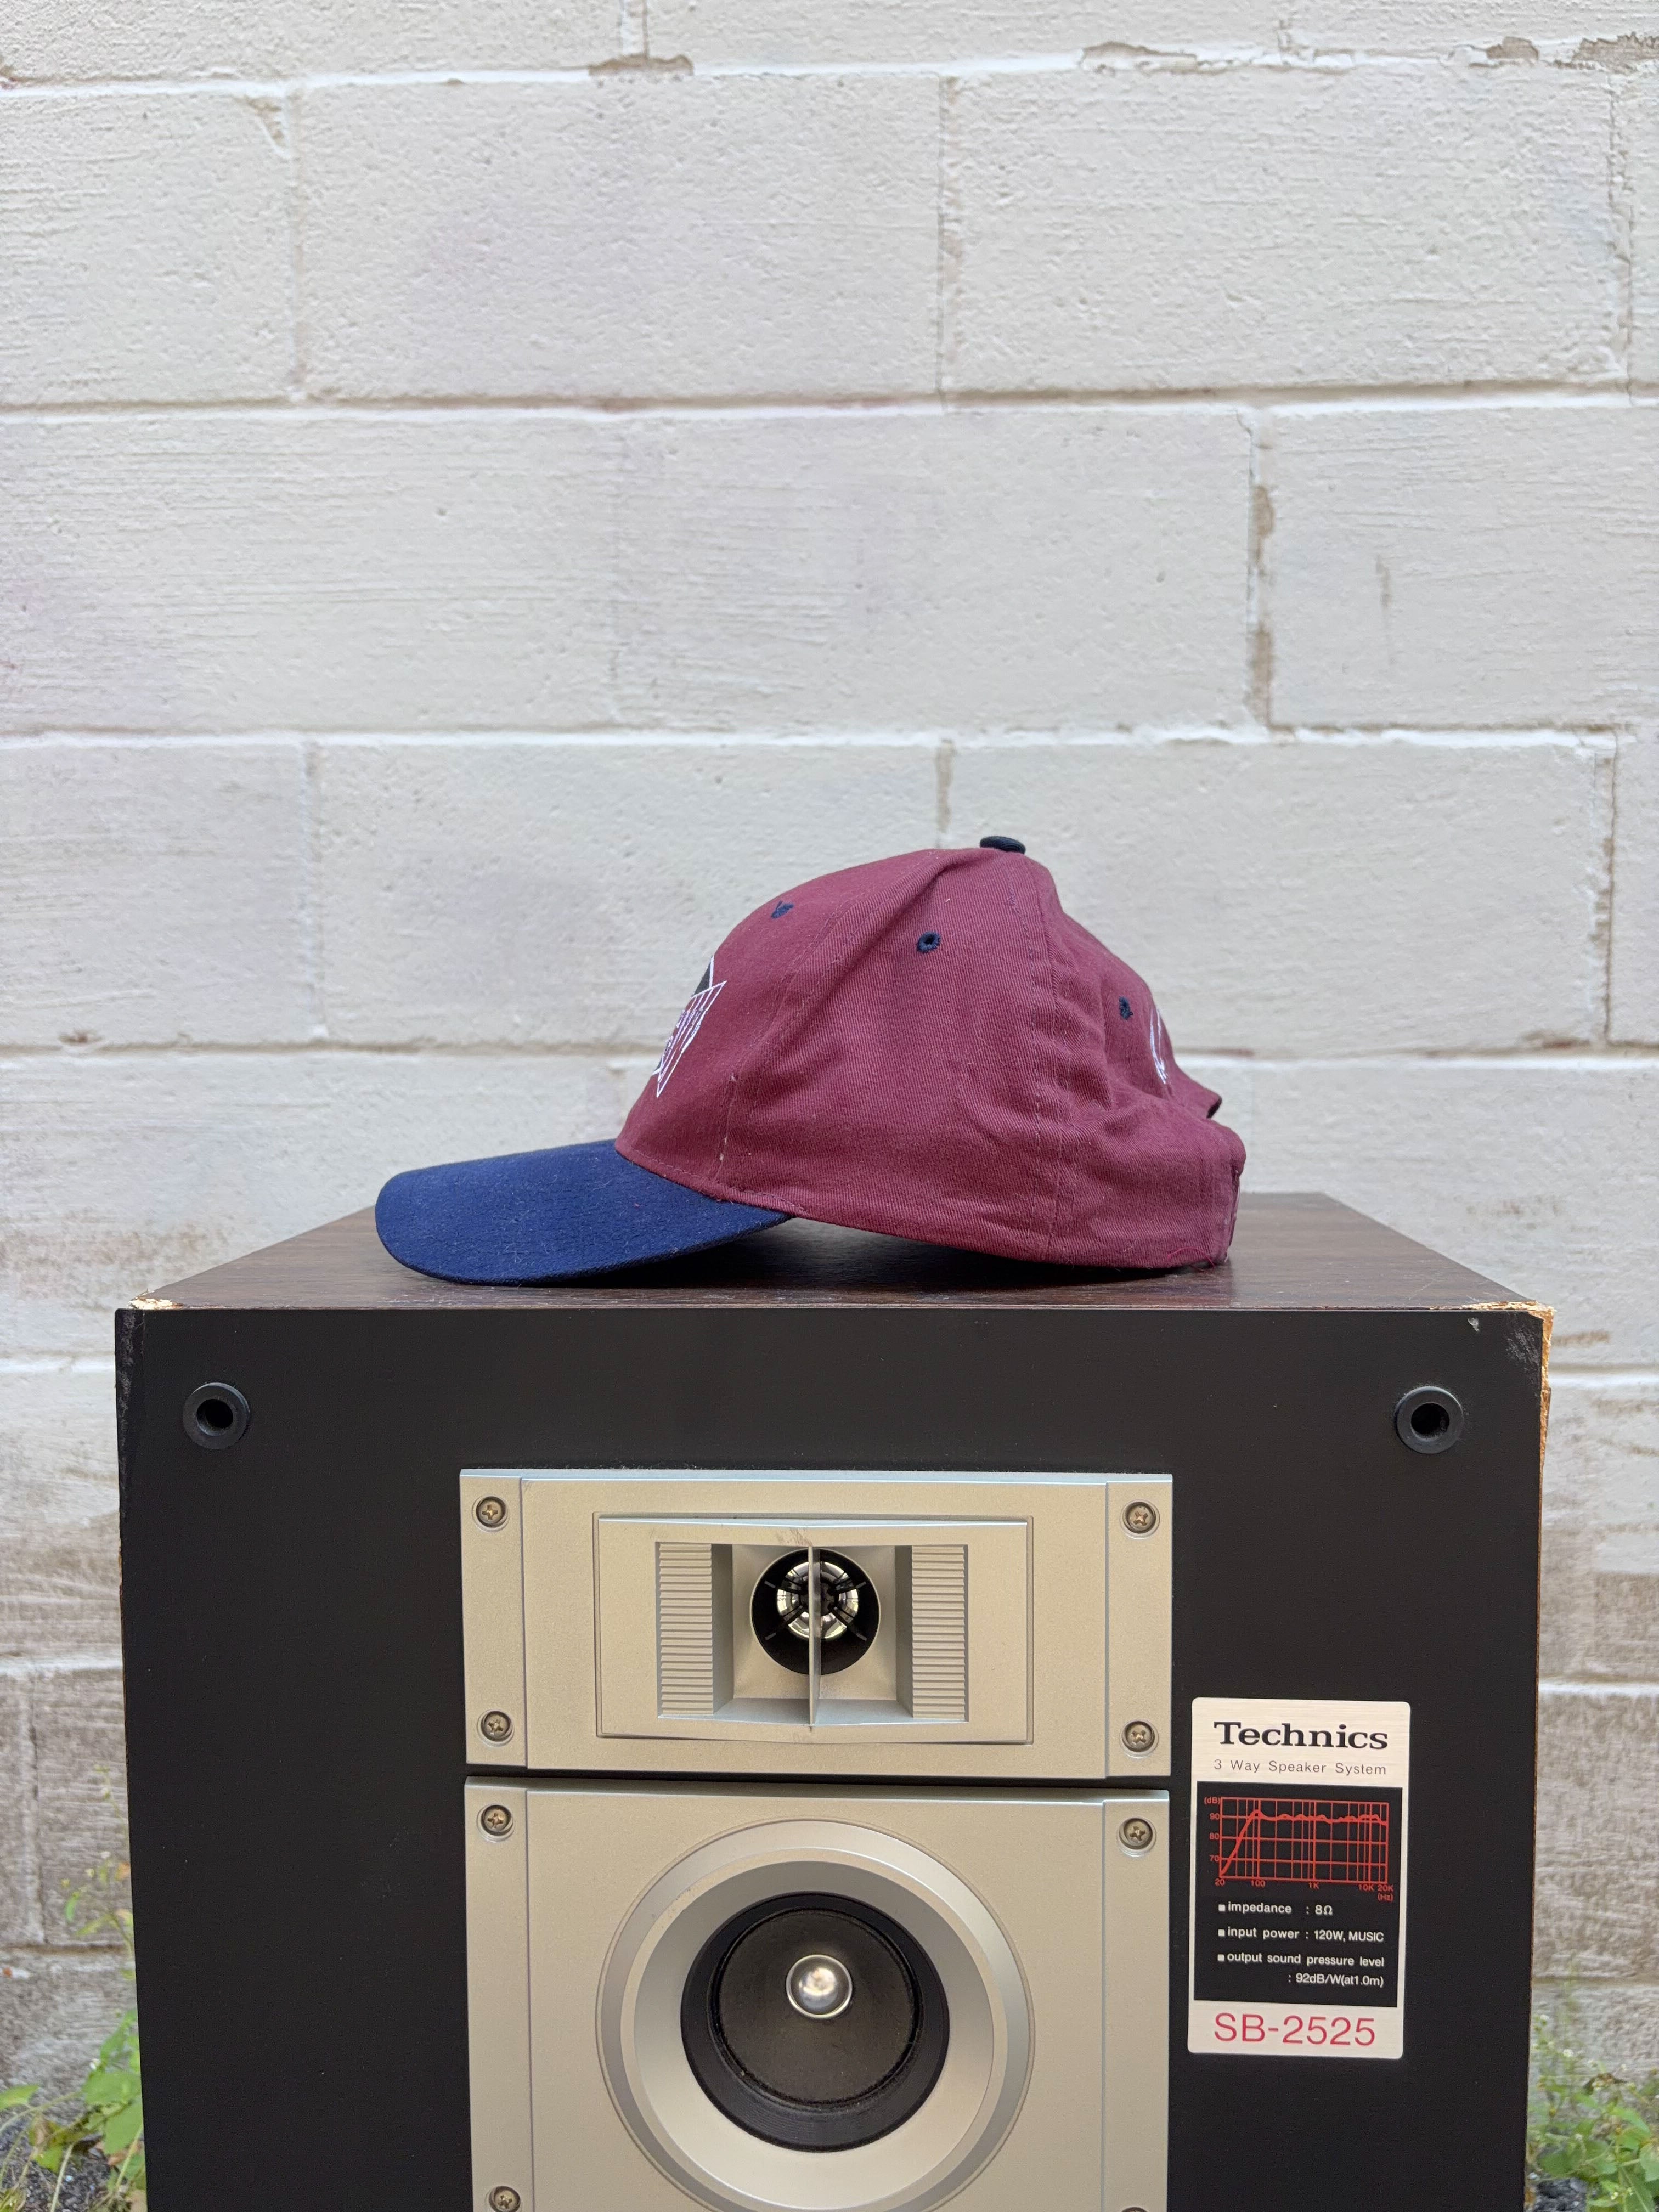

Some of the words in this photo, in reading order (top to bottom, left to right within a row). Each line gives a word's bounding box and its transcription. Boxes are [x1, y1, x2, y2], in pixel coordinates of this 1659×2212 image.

[1214, 1722, 1388, 1750] Technics
[1214, 1759, 1222, 1770] 3
[1231, 1759, 1260, 1773] Way
[1269, 1760, 1327, 1774] Speaker
[1335, 1762, 1386, 1776] System
[1204, 1797, 1221, 1805] (dB)
[1215, 1878, 1225, 1887] 20
[1378, 1893, 1394, 1901] (Hz)
[1228, 1901, 1292, 1914] impedance
[1227, 1927, 1257, 1939] input
[1263, 1931, 1300, 1940] power
[1348, 1931, 1384, 1942] MUSIC
[1227, 1953, 1262, 1963] output
[1267, 1954, 1301, 1964] sound
[1307, 1957, 1355, 1967] pressure
[1360, 1956, 1384, 1967] level
[1214, 2012, 1375, 2046] SB-2525
